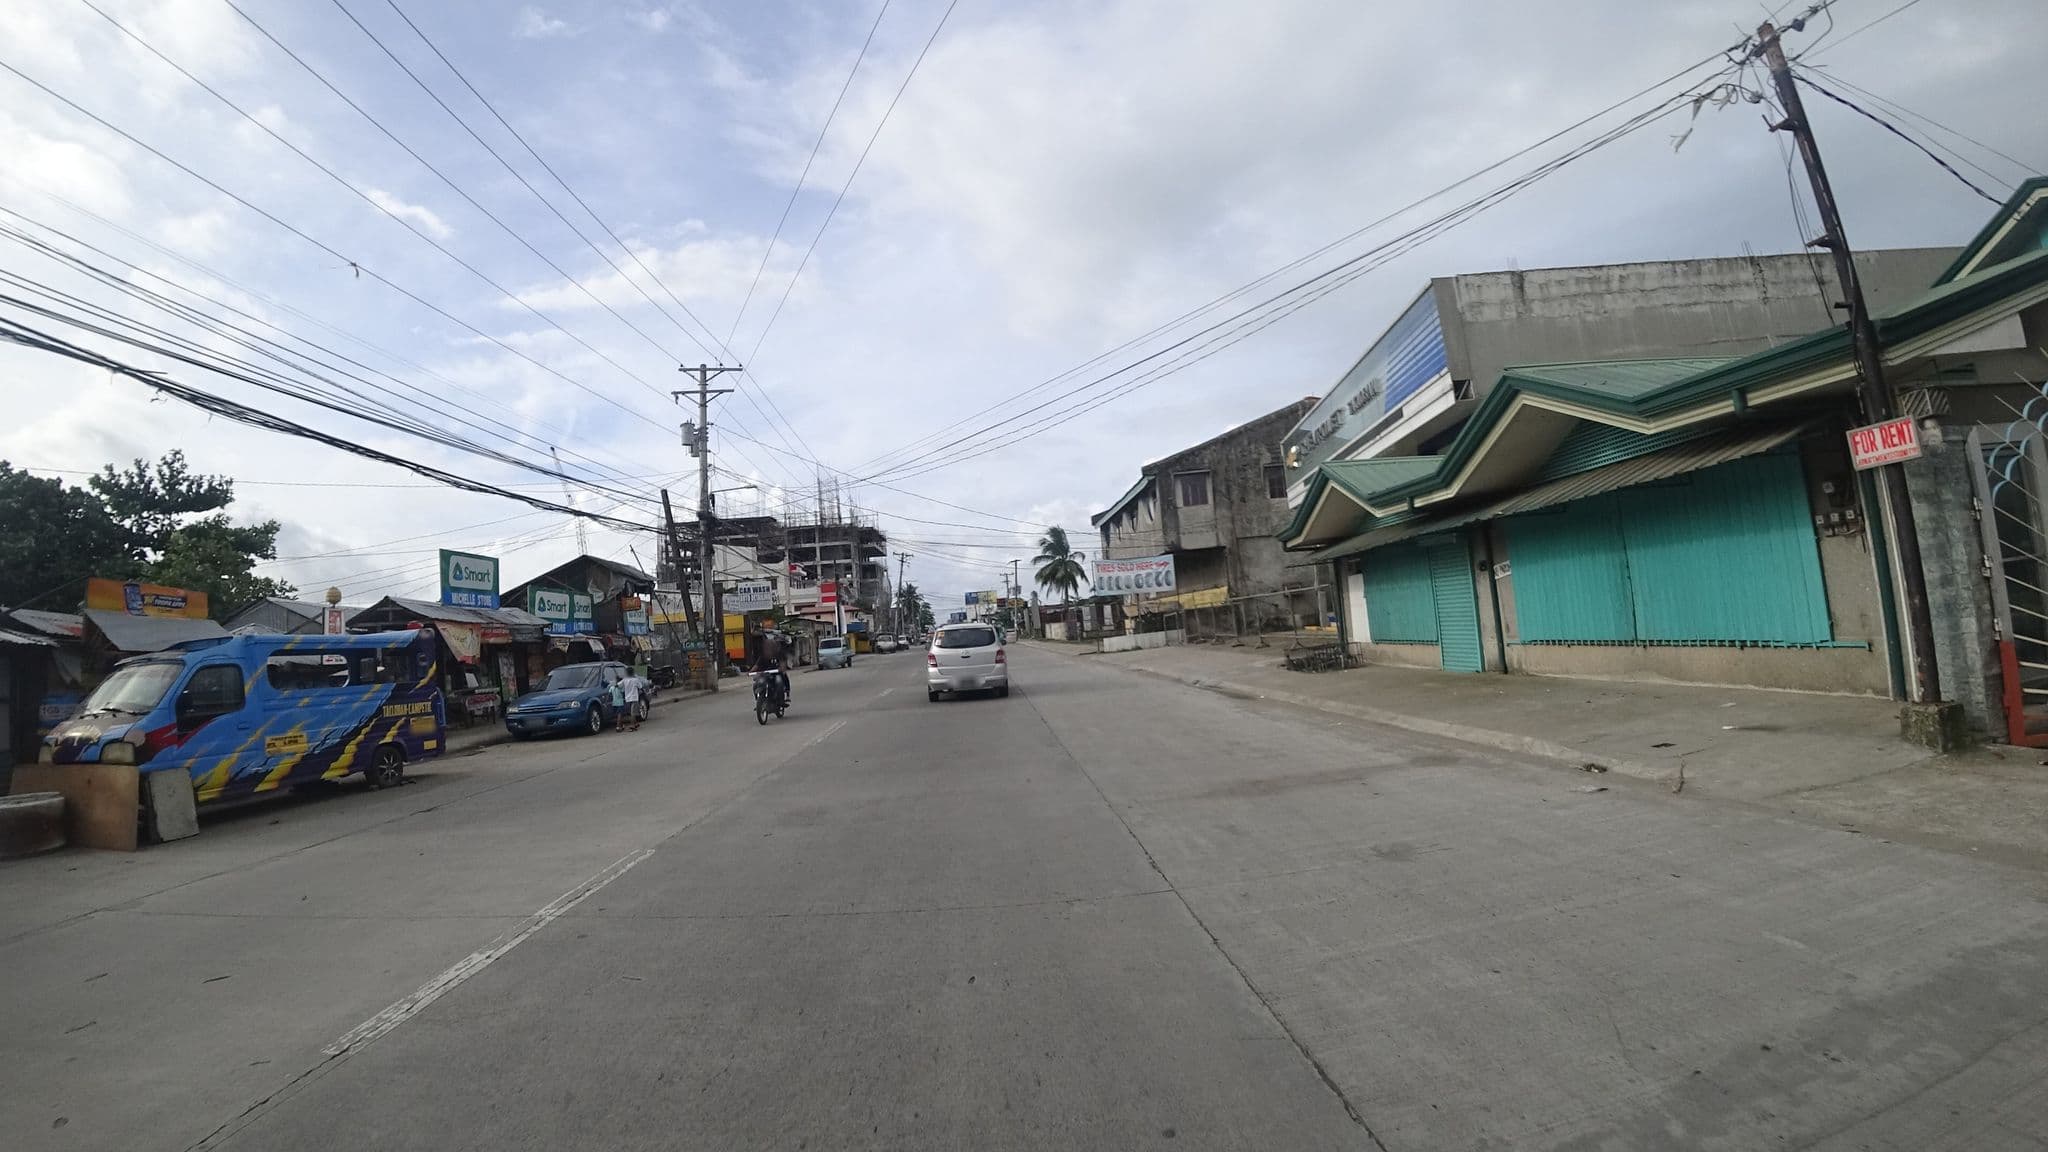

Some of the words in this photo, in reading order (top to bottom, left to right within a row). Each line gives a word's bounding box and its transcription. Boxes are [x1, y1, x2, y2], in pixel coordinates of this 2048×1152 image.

[1852, 428, 1879, 456] FOR
[1879, 419, 1914, 449] RENT
[464, 566, 491, 583] Smart
[752, 585, 770, 593] WASH
[477, 594, 492, 607] STORE
[546, 599, 567, 613] Smart
